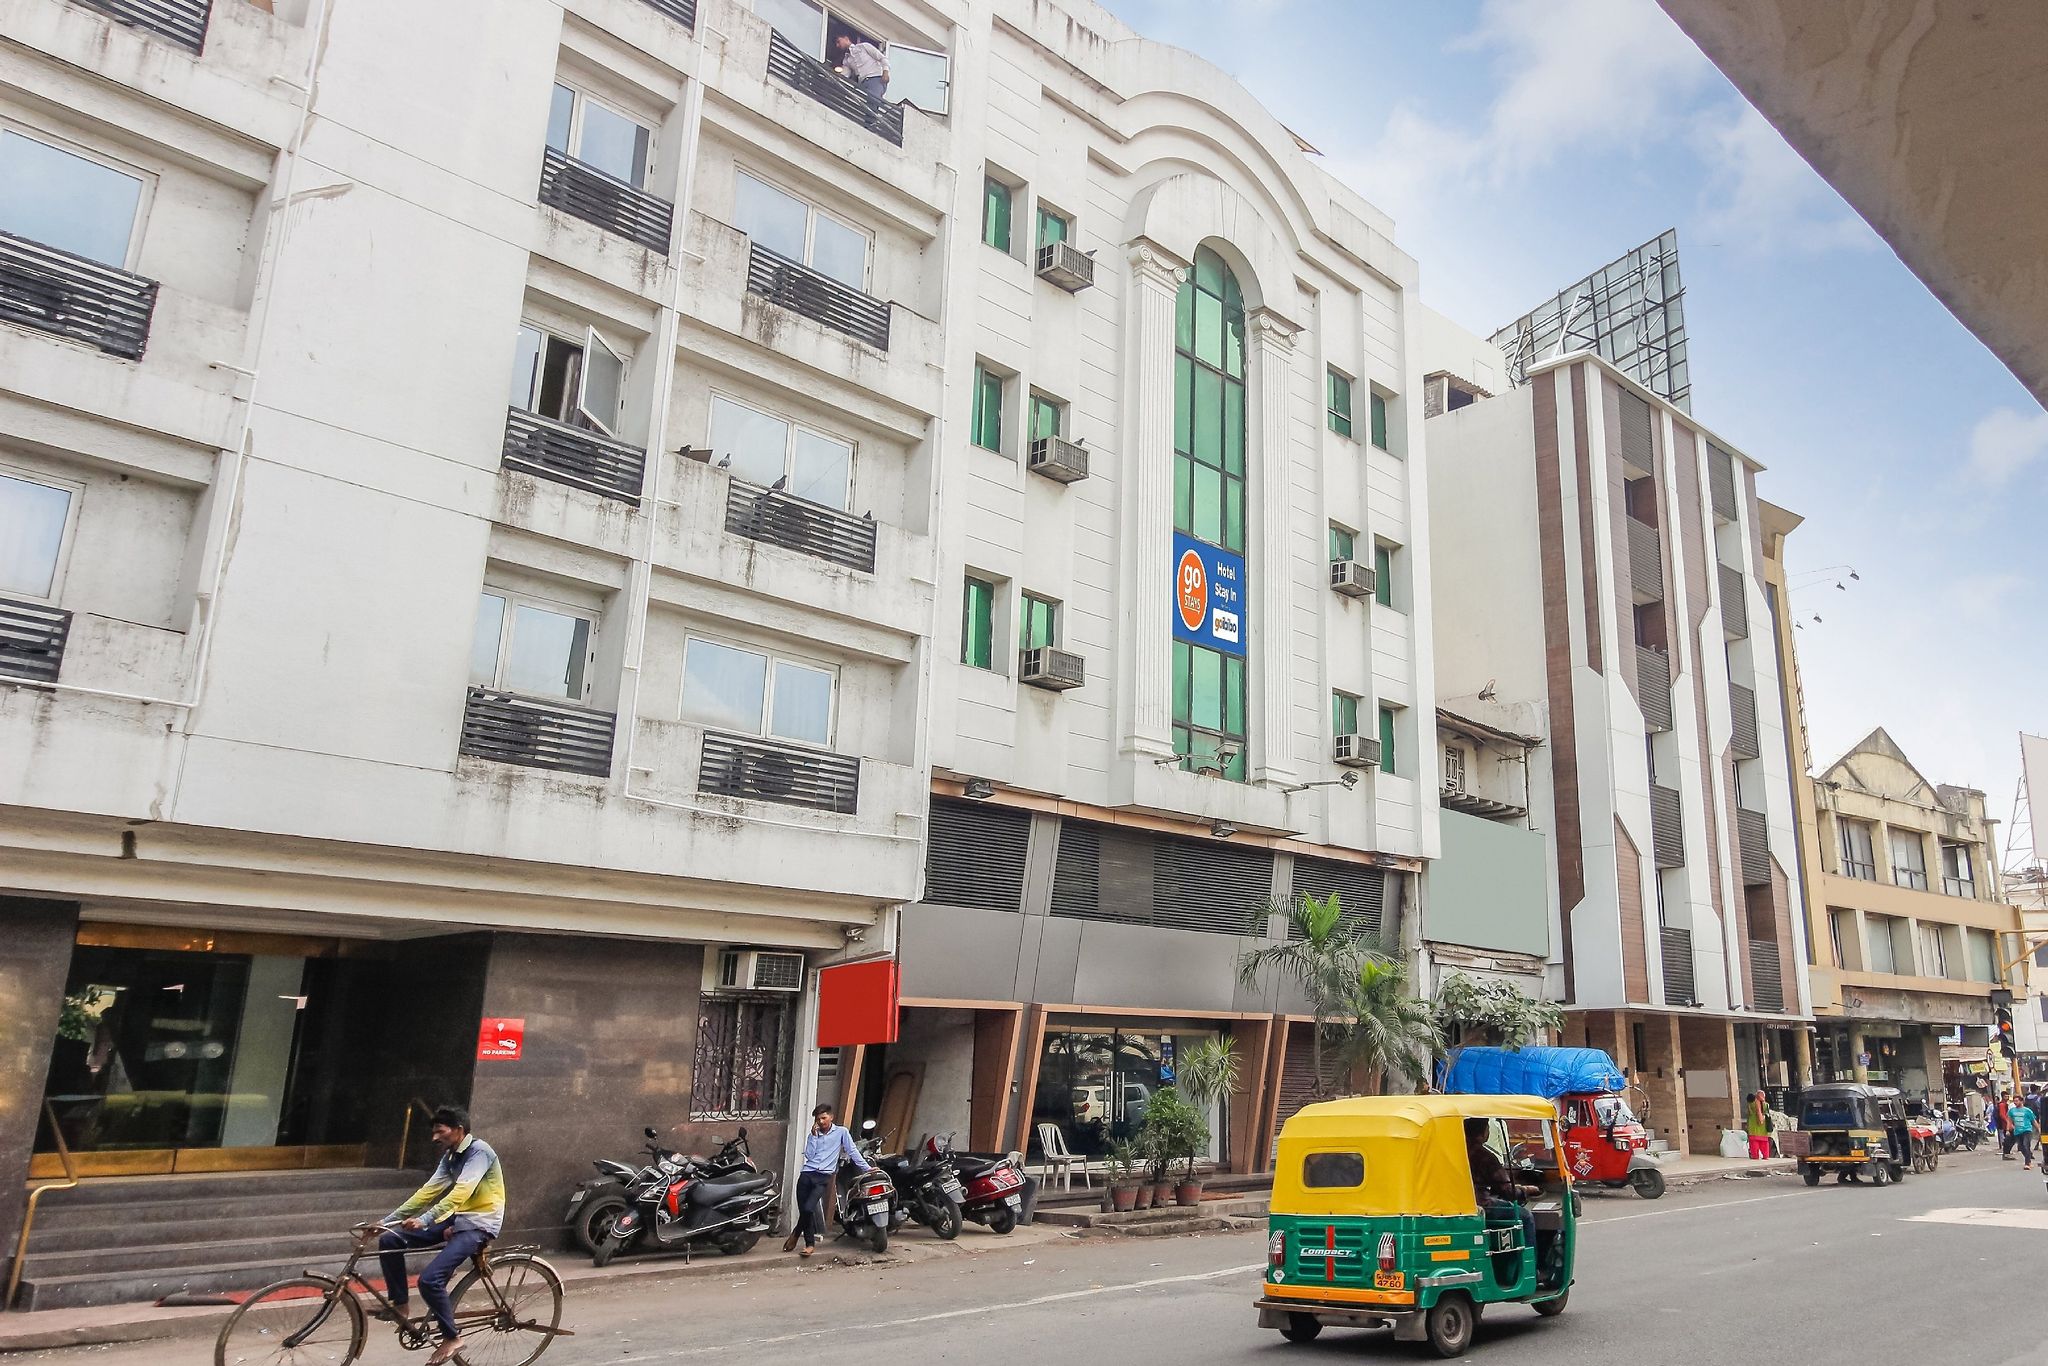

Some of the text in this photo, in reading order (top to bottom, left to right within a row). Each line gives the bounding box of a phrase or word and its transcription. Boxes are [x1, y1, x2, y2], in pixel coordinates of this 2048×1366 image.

[1184, 565, 1201, 594] go
[1217, 561, 1236, 580] Hotel
[1184, 594, 1201, 609] STAYS
[1214, 582, 1229, 603] Stay
[1214, 616, 1237, 633] goibibo
[1376, 1280, 1402, 1288] 4760
